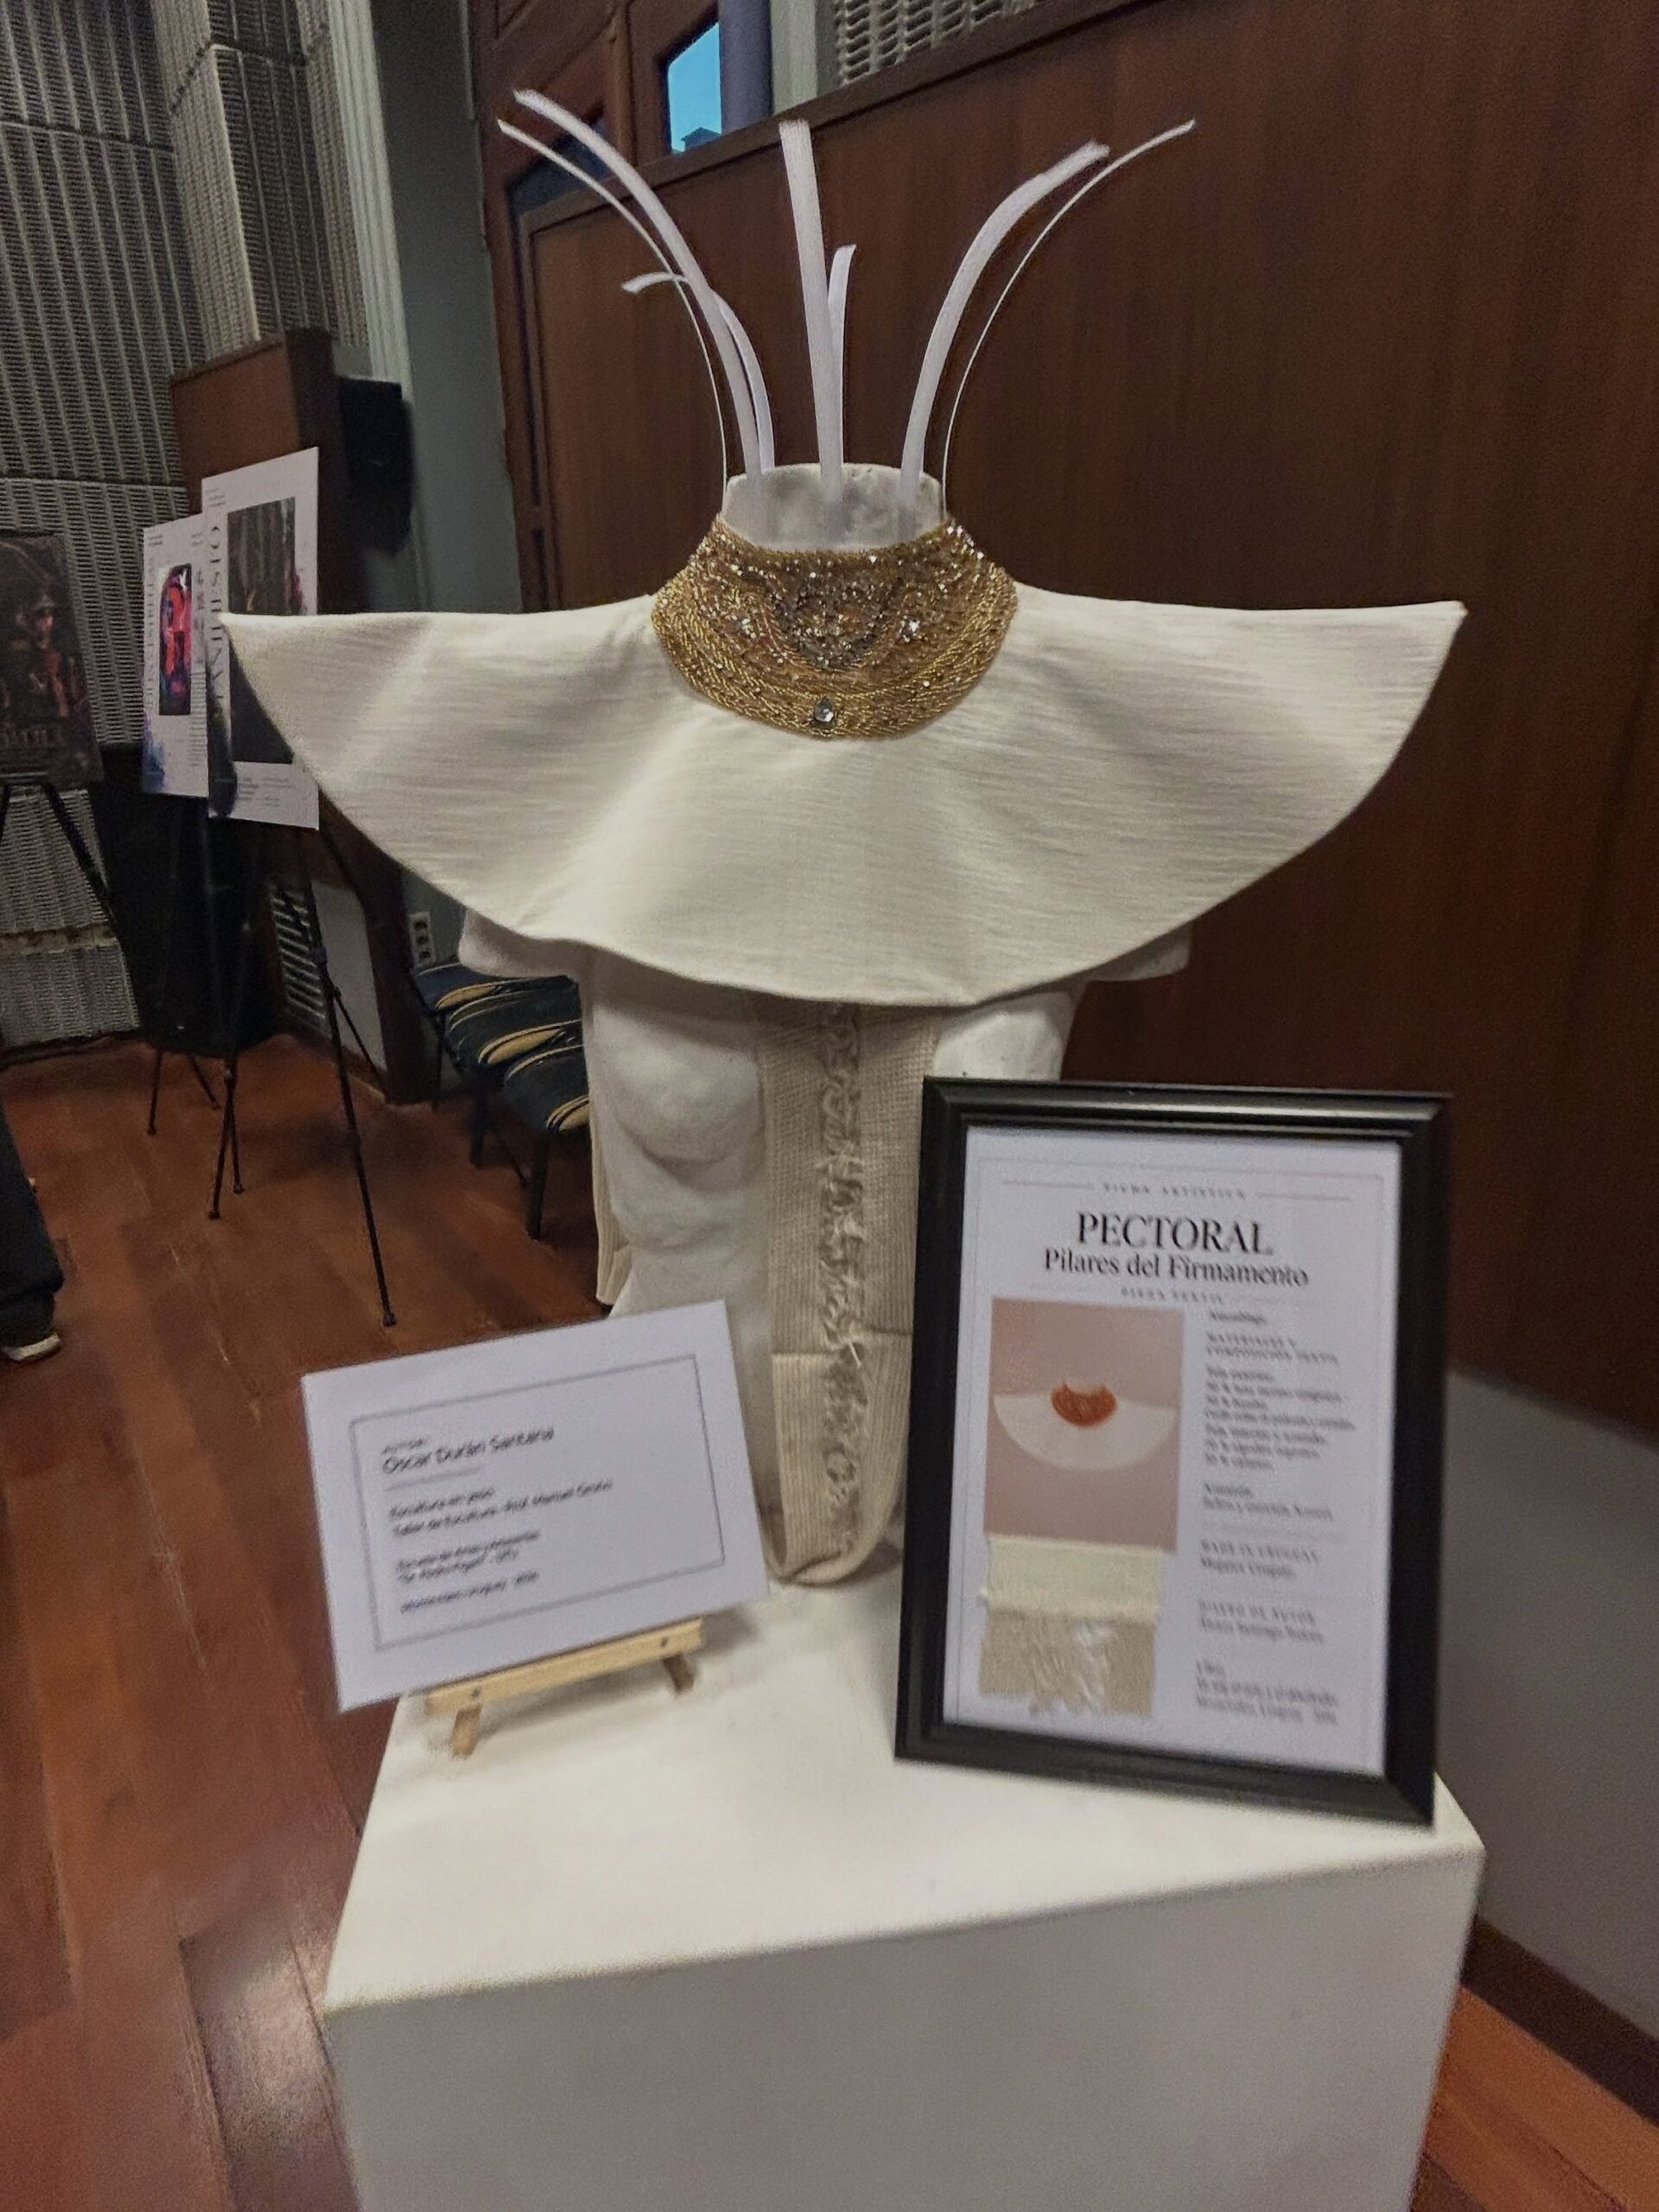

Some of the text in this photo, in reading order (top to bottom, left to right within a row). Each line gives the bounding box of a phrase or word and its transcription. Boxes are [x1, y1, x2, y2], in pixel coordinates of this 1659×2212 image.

[1077, 1211, 1274, 1256] PECTORAL
[1043, 1247, 1310, 1287] Pilares del Firmamento
[383, 1452, 432, 1474] Oscar
